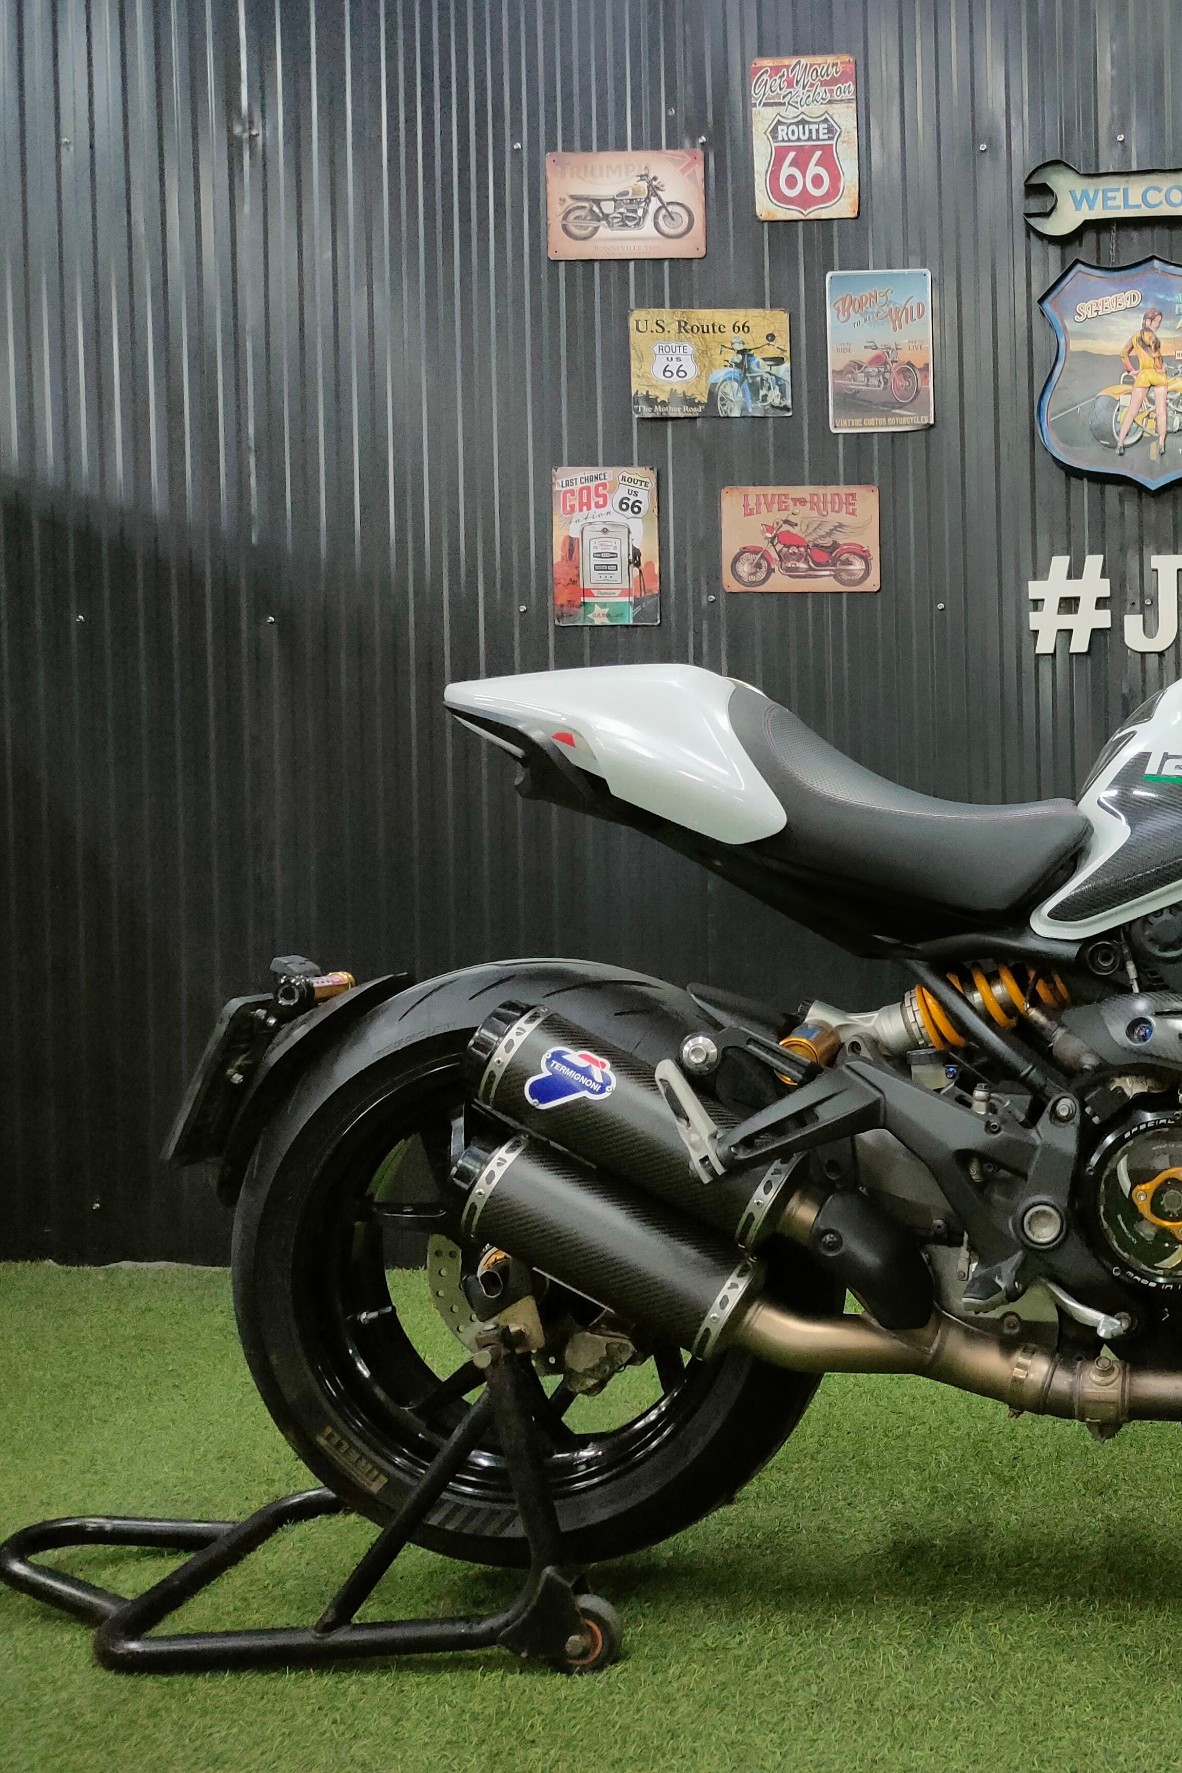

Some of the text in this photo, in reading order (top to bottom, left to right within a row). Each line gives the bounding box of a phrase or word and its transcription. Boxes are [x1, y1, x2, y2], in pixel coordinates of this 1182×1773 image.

[752, 59, 842, 108] Get Your
[781, 81, 854, 113] Kicks on
[777, 123, 830, 141] ROUTE
[779, 150, 830, 198] 66
[876, 296, 926, 332] WILD
[1074, 289, 1143, 323] SPEED
[635, 319, 750, 334] U.S. Route 66
[658, 345, 688, 354] ROUTE
[662, 364, 687, 378] 66
[561, 472, 607, 488] LAST CHANCE
[620, 475, 650, 488] ROUTE
[561, 482, 608, 515] GAS
[627, 489, 639, 498] US
[618, 497, 643, 515] 66
[743, 493, 790, 517] LIVE
[809, 492, 857, 517] RIDE
[550, 1059, 601, 1092] TERMIGNONI
